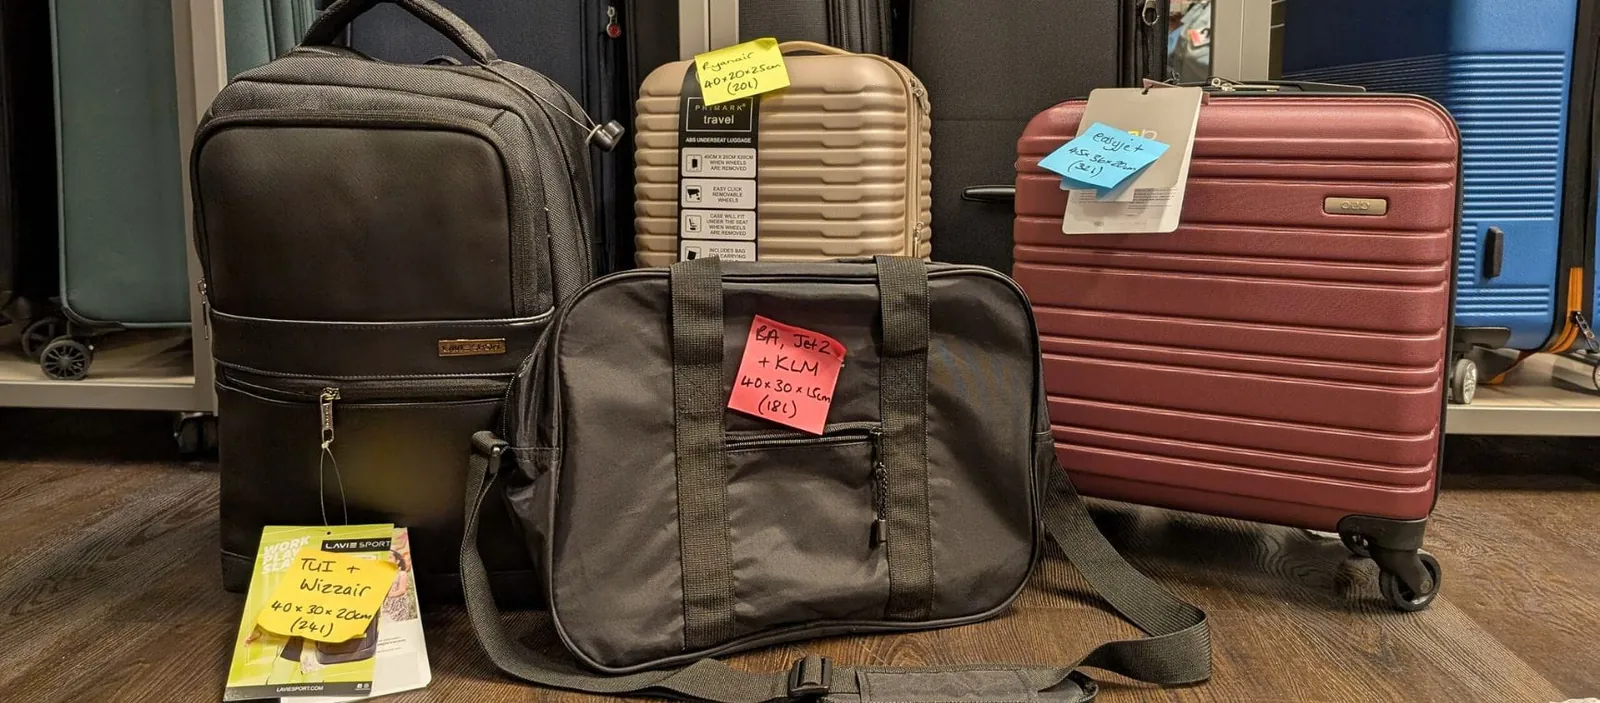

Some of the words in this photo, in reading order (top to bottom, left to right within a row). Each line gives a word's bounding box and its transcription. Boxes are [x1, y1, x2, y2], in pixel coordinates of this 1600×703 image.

[703, 51, 755, 72] Ryanair
[703, 114, 734, 125] travel
[775, 354, 819, 376] KLM
[264, 535, 311, 554] WORK
[325, 542, 357, 550] LAVIE
[359, 540, 390, 548] SPORT
[301, 558, 336, 573] TUI
[300, 578, 371, 597] Wizzair
